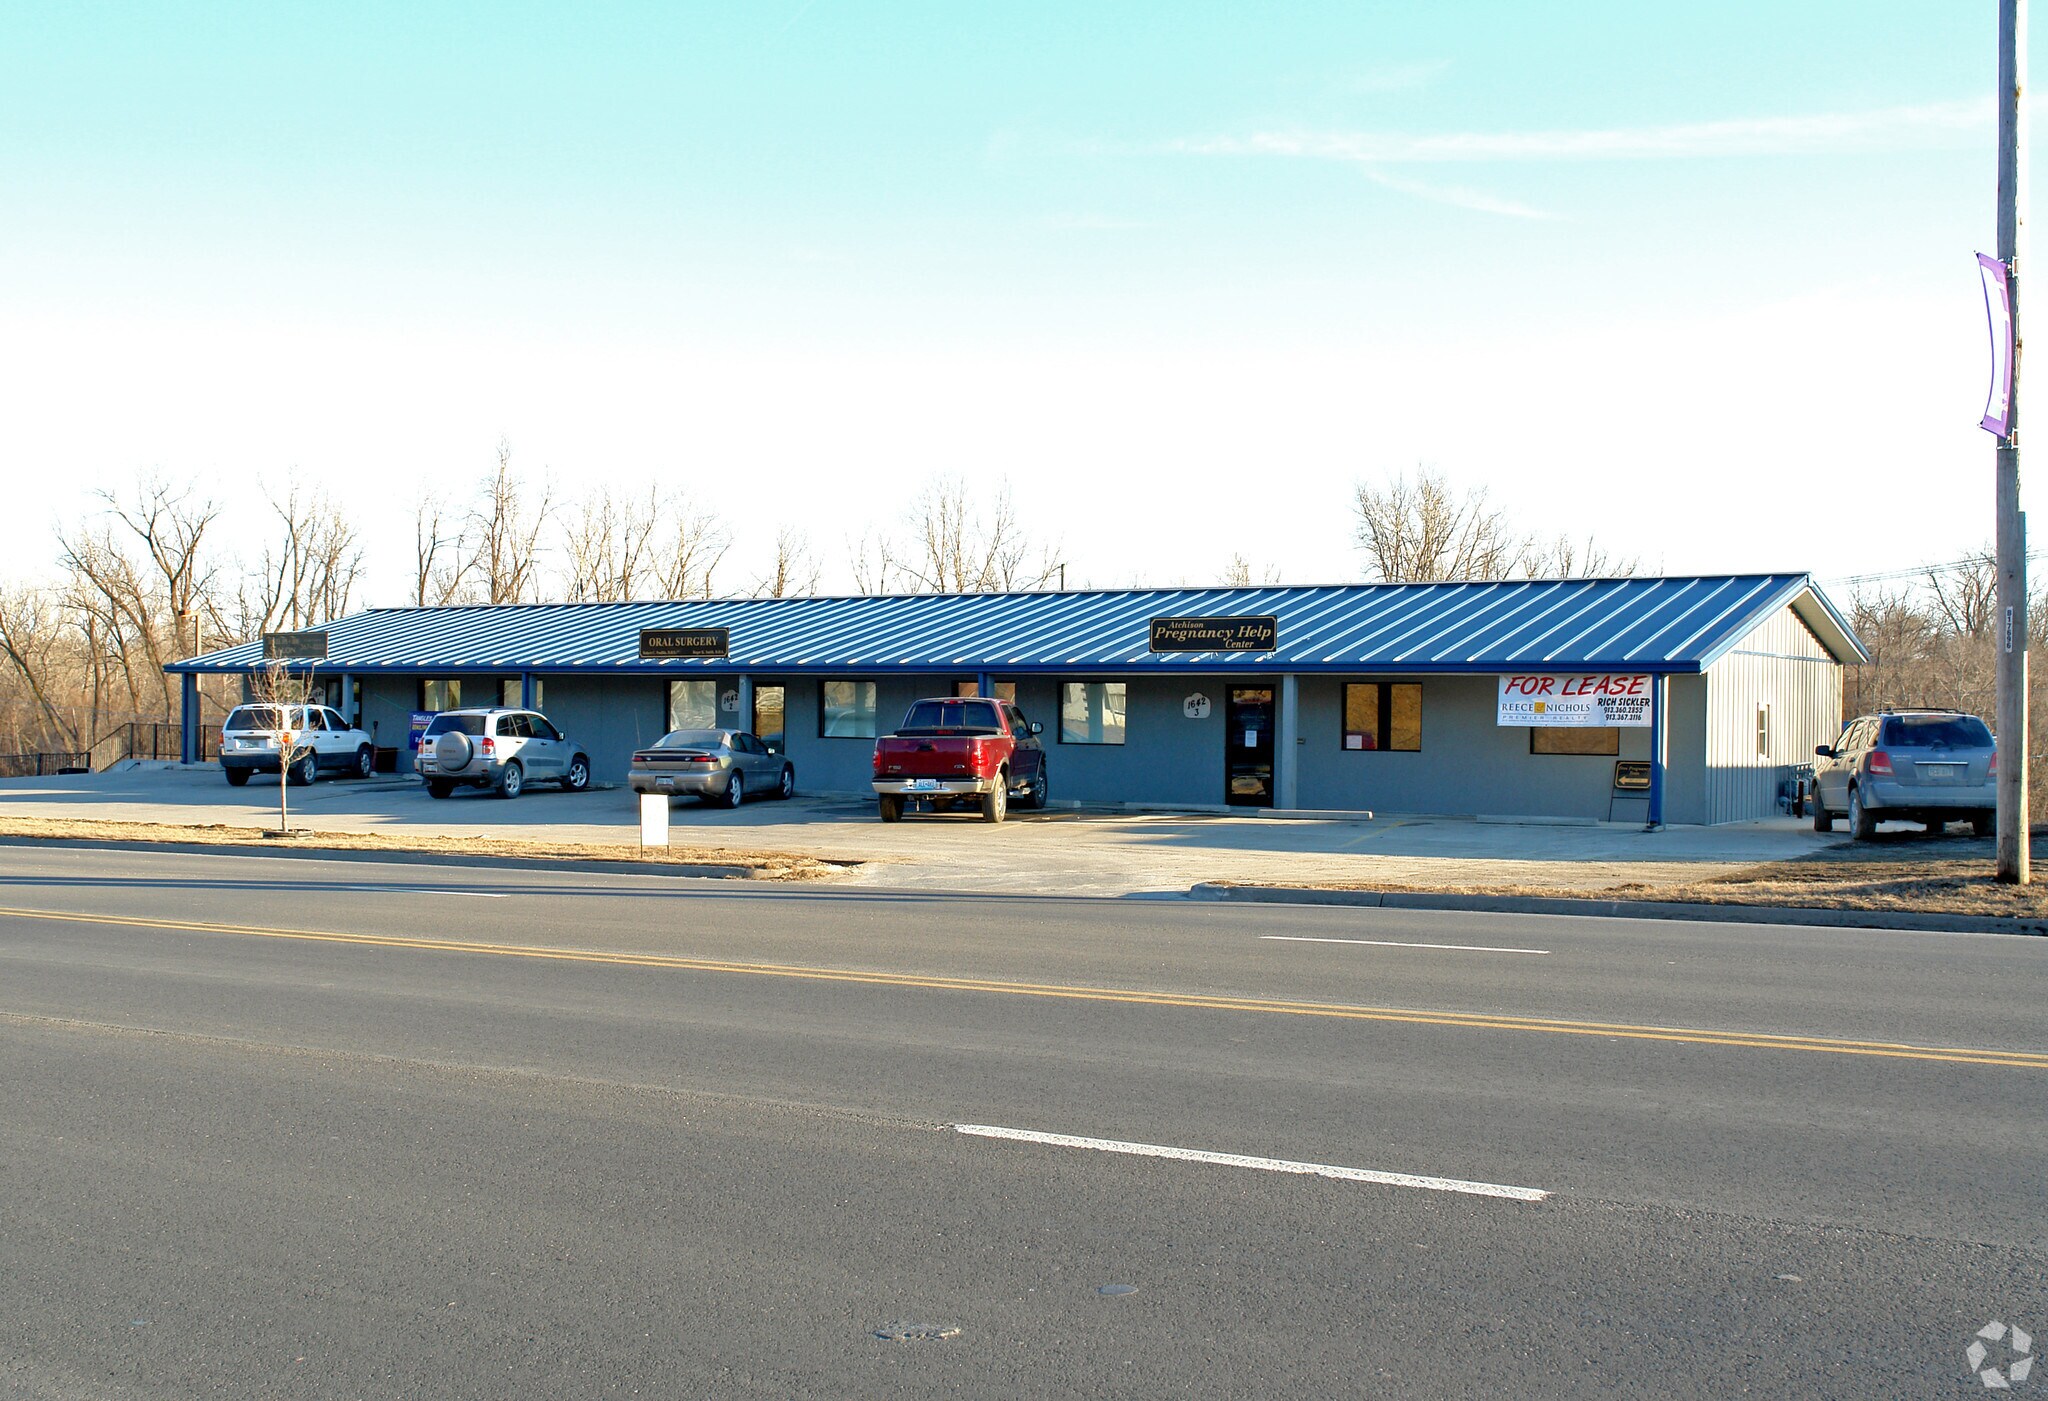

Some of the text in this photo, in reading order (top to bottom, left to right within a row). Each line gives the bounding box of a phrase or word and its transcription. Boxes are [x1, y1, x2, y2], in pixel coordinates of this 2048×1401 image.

[1168, 621, 1204, 629] Atchison
[1154, 625, 1272, 642] Pregnancy Help
[648, 636, 719, 647] ORAL SURGERY
[1225, 640, 1255, 649] Center
[1504, 674, 1648, 696] FOR LEASE
[1187, 697, 1206, 710] 1642
[1597, 697, 1651, 707] RICH SICKLER
[1194, 708, 1199, 717] 3
[1501, 703, 1591, 712] REECE NICHOLS
